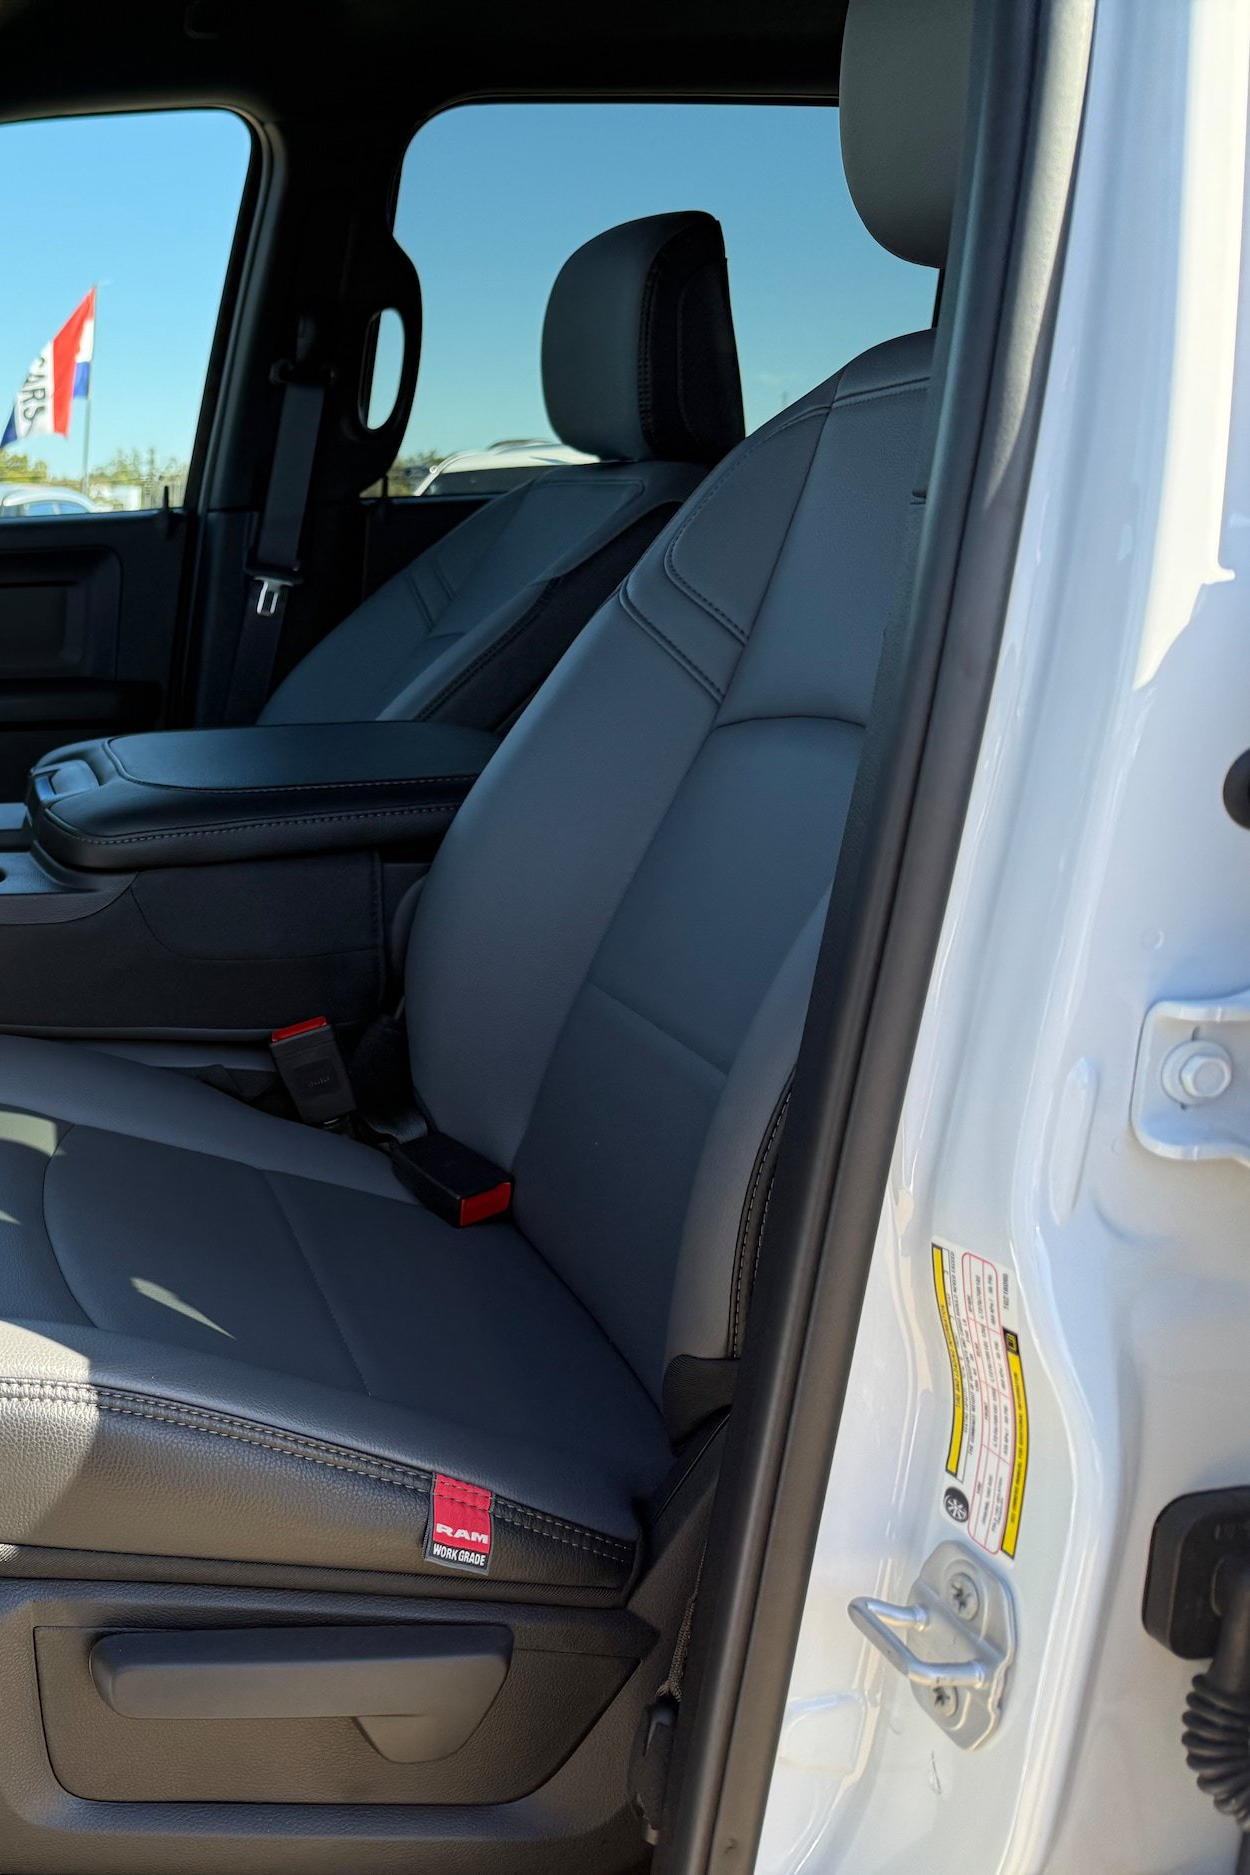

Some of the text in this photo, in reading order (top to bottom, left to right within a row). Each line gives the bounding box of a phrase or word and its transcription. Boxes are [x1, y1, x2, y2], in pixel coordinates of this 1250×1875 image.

[436, 1523, 488, 1544] RAM
[433, 1543, 486, 1566] WORK GRADE
